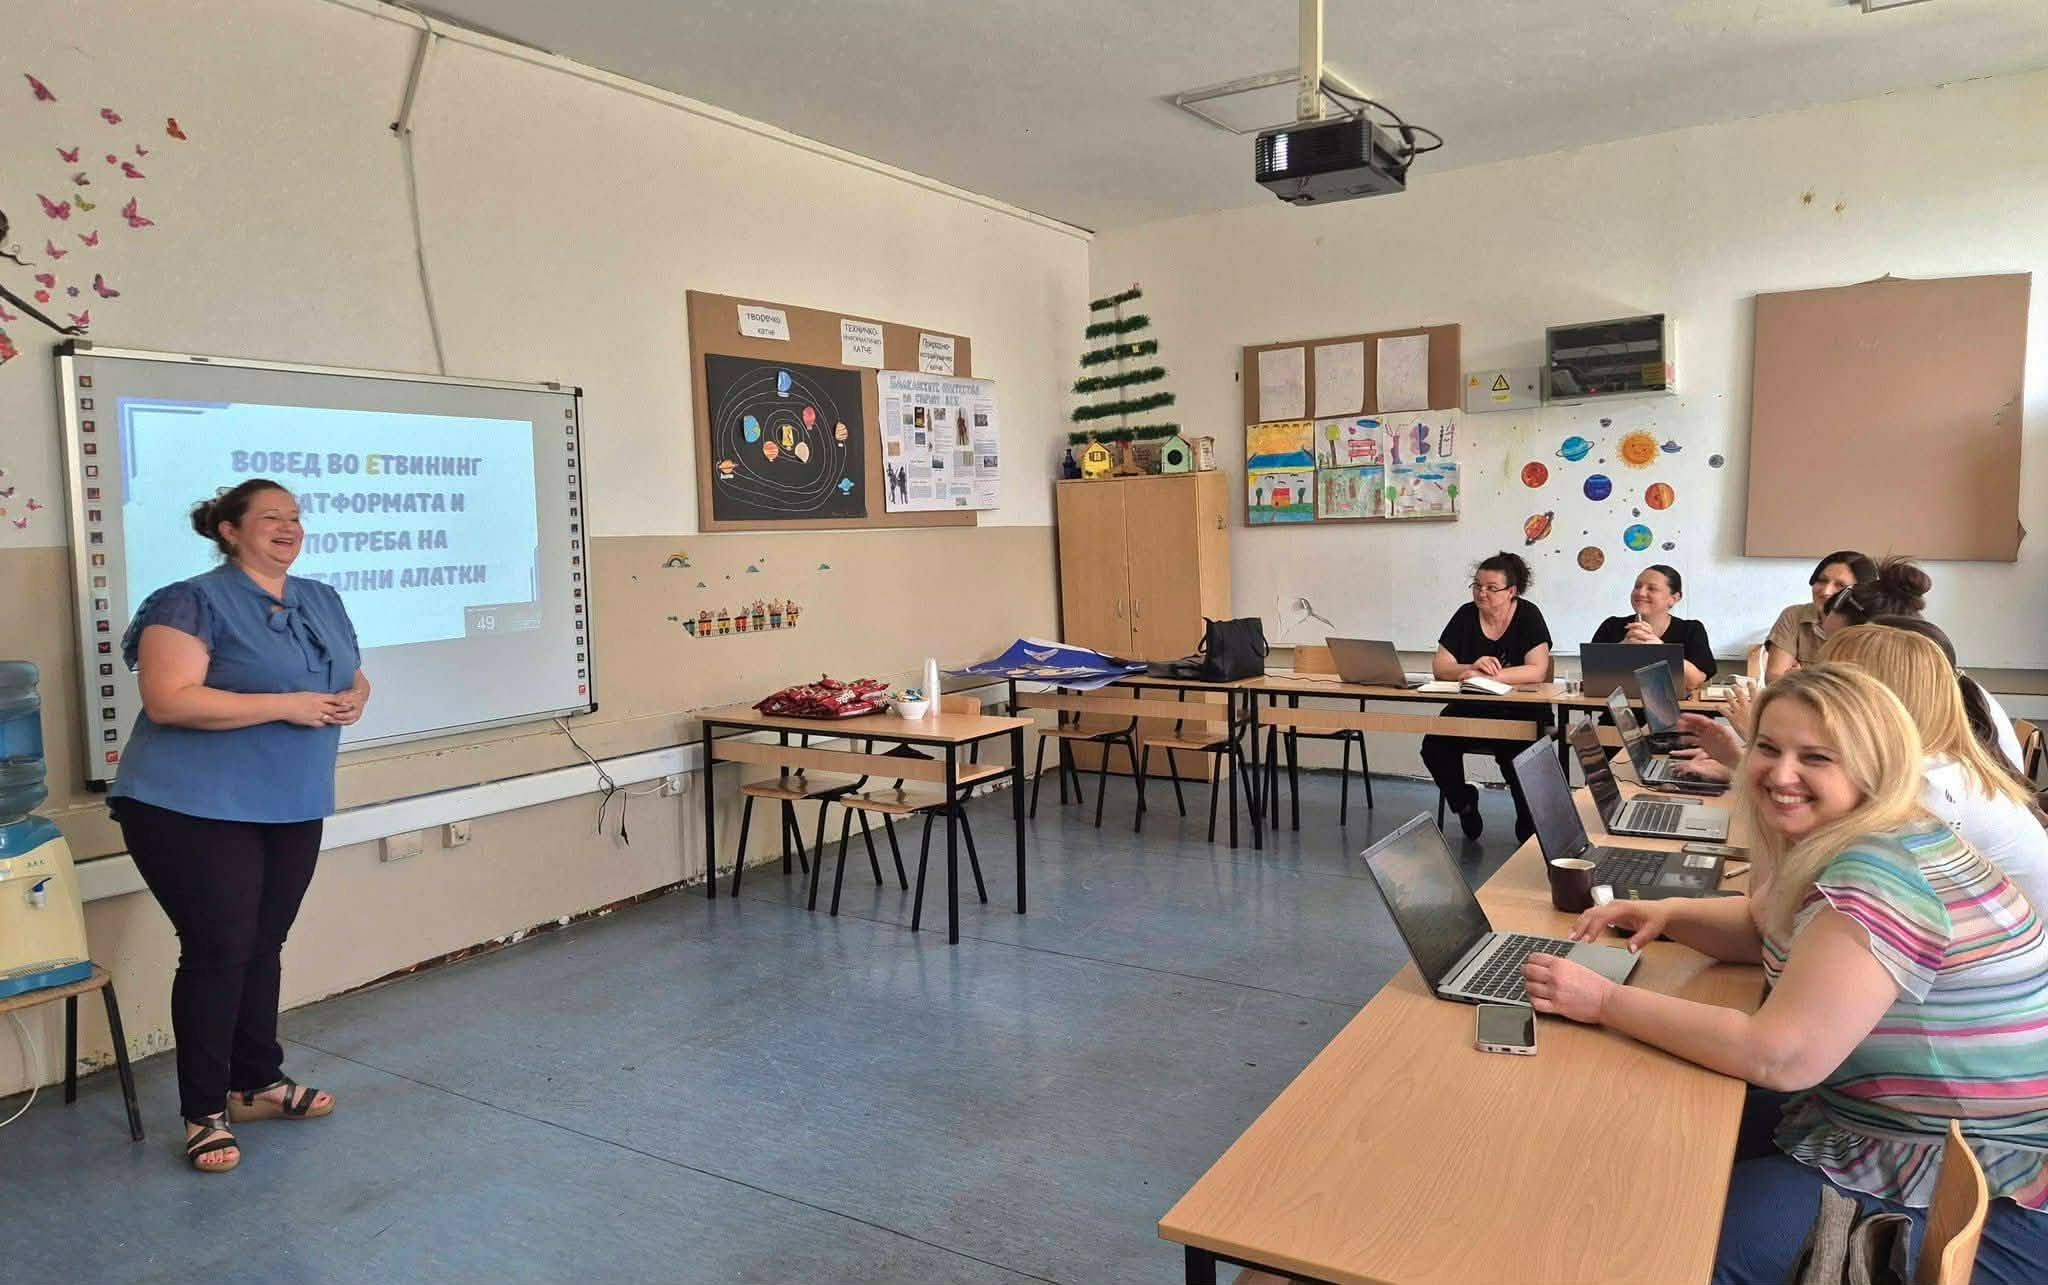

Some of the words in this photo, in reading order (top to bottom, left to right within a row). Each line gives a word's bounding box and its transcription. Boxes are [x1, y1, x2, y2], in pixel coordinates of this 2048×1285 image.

[231, 450, 321, 478] ВОВЕД
[327, 453, 359, 475] ВО
[366, 454, 482, 476] ЕТВИНИНГ
[298, 492, 446, 514] АТФОРМАТА
[451, 493, 465, 512] И
[304, 530, 411, 554] ПОТРЕБА
[418, 529, 448, 550] НА
[400, 564, 487, 588] АЛАТКИ
[476, 615, 495, 631] 49
